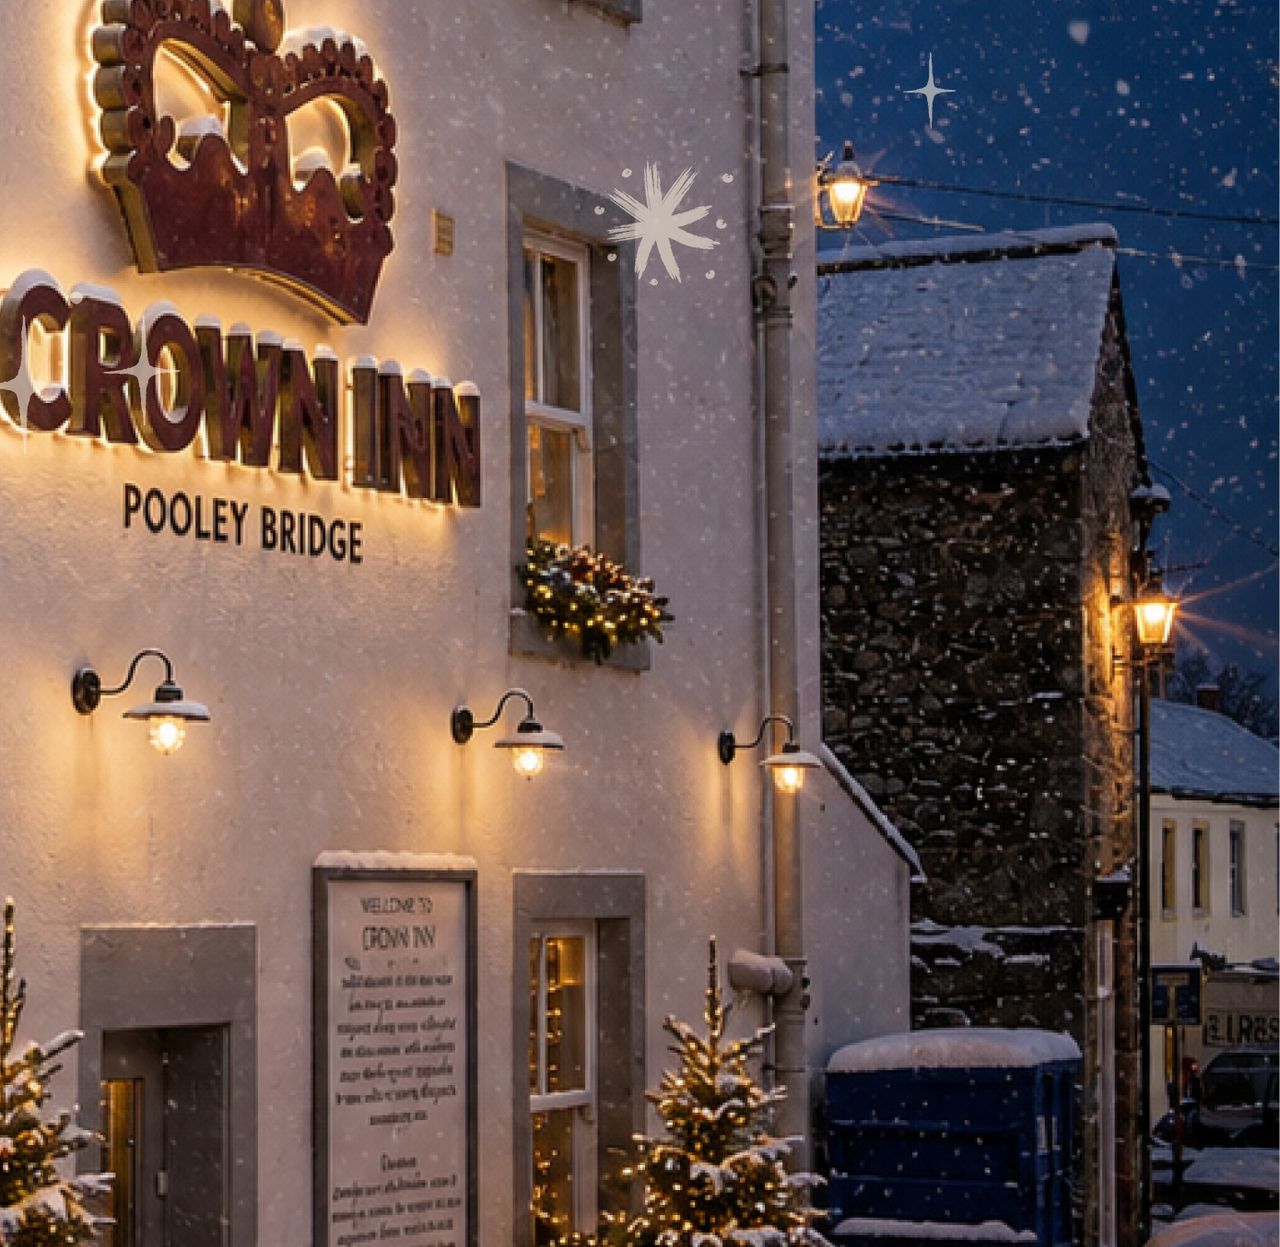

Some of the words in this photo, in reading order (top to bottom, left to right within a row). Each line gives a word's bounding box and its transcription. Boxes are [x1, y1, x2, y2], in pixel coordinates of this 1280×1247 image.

[351, 358, 481, 509] INN
[122, 482, 249, 546] POOLEY
[260, 505, 364, 565] BRIDGE
